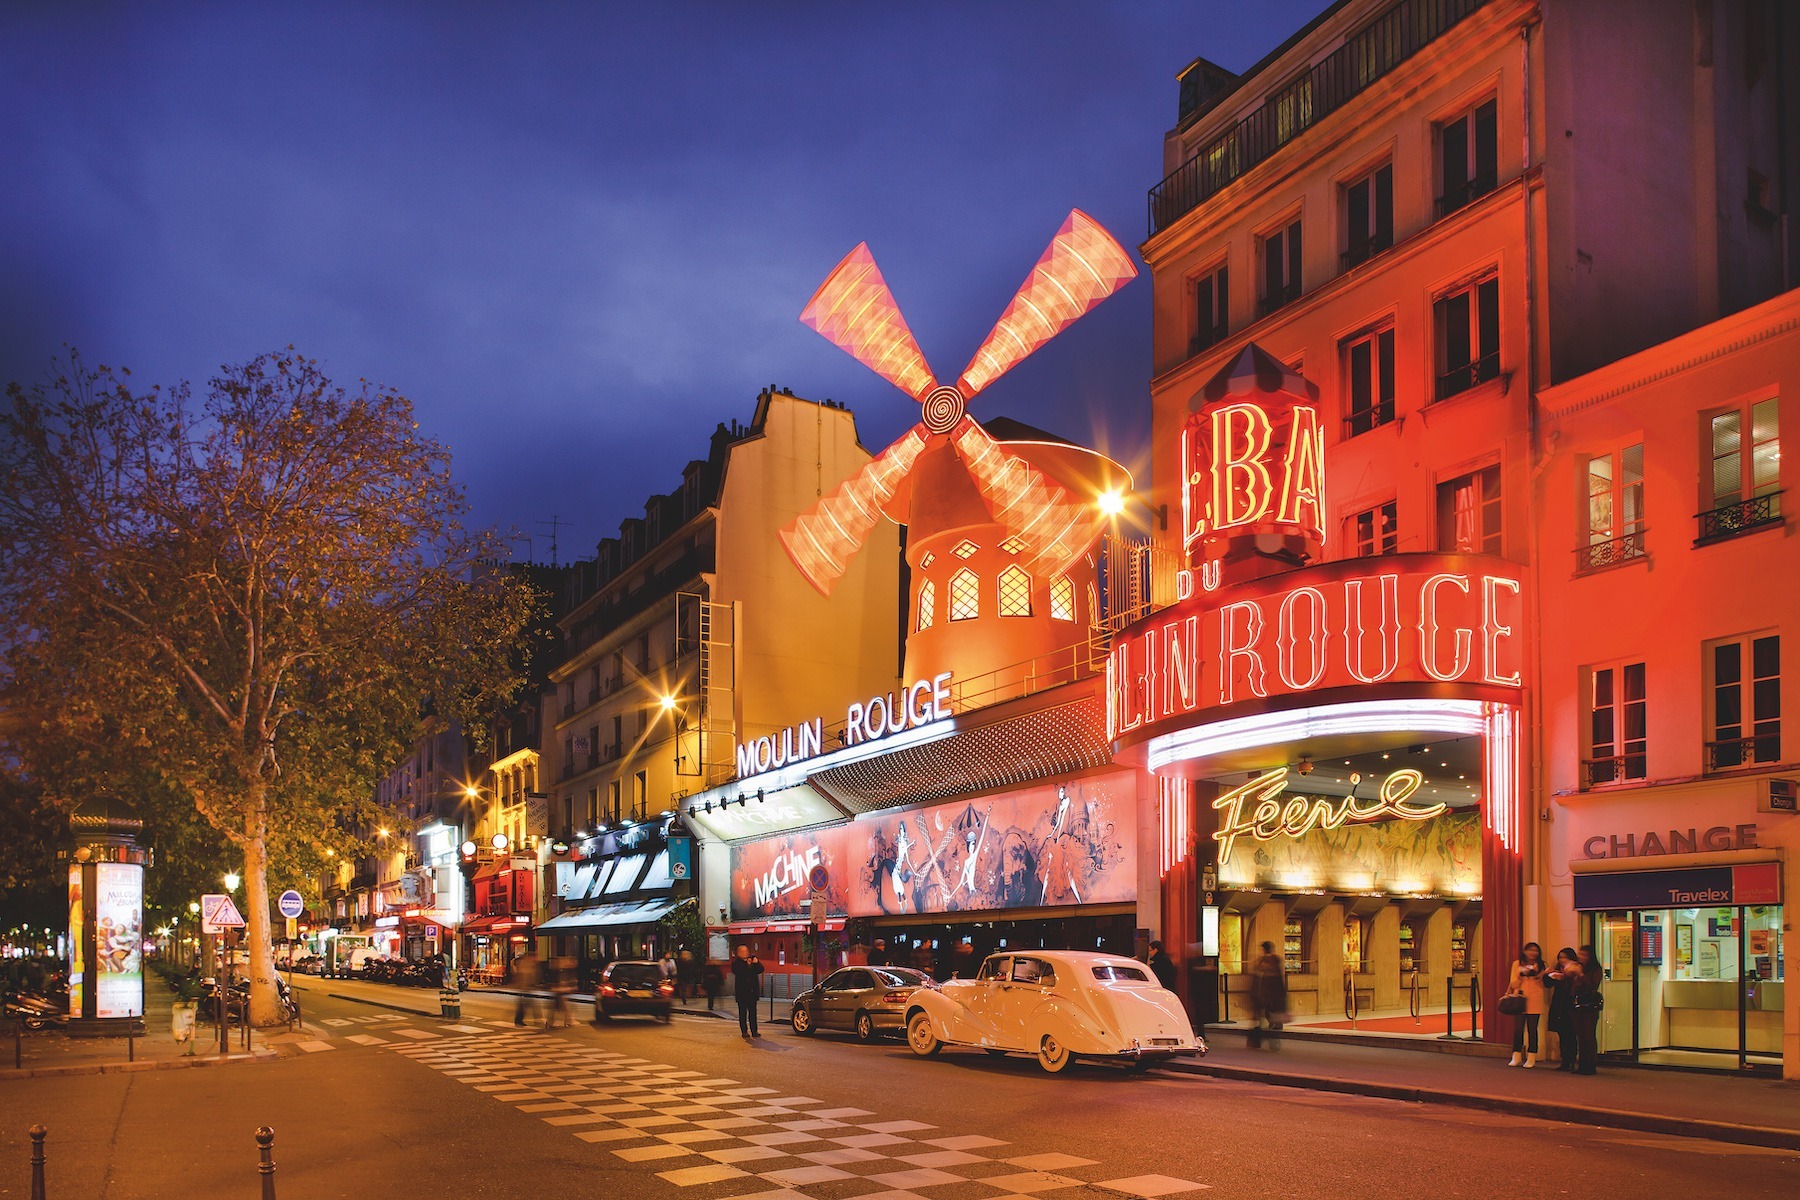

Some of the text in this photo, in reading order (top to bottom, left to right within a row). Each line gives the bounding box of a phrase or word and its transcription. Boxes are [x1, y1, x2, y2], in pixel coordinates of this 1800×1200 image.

[1176, 559, 1220, 601] DU
[1219, 573, 1521, 704] ROUGE
[737, 671, 954, 779] MOULIN ROUGE
[1583, 823, 1759, 860] CHANGE
[753, 844, 820, 909] MACHINE
[1668, 887, 1730, 903] Travelex
[428, 927, 435, 935] P
[319, 1013, 409, 1028] BUS
